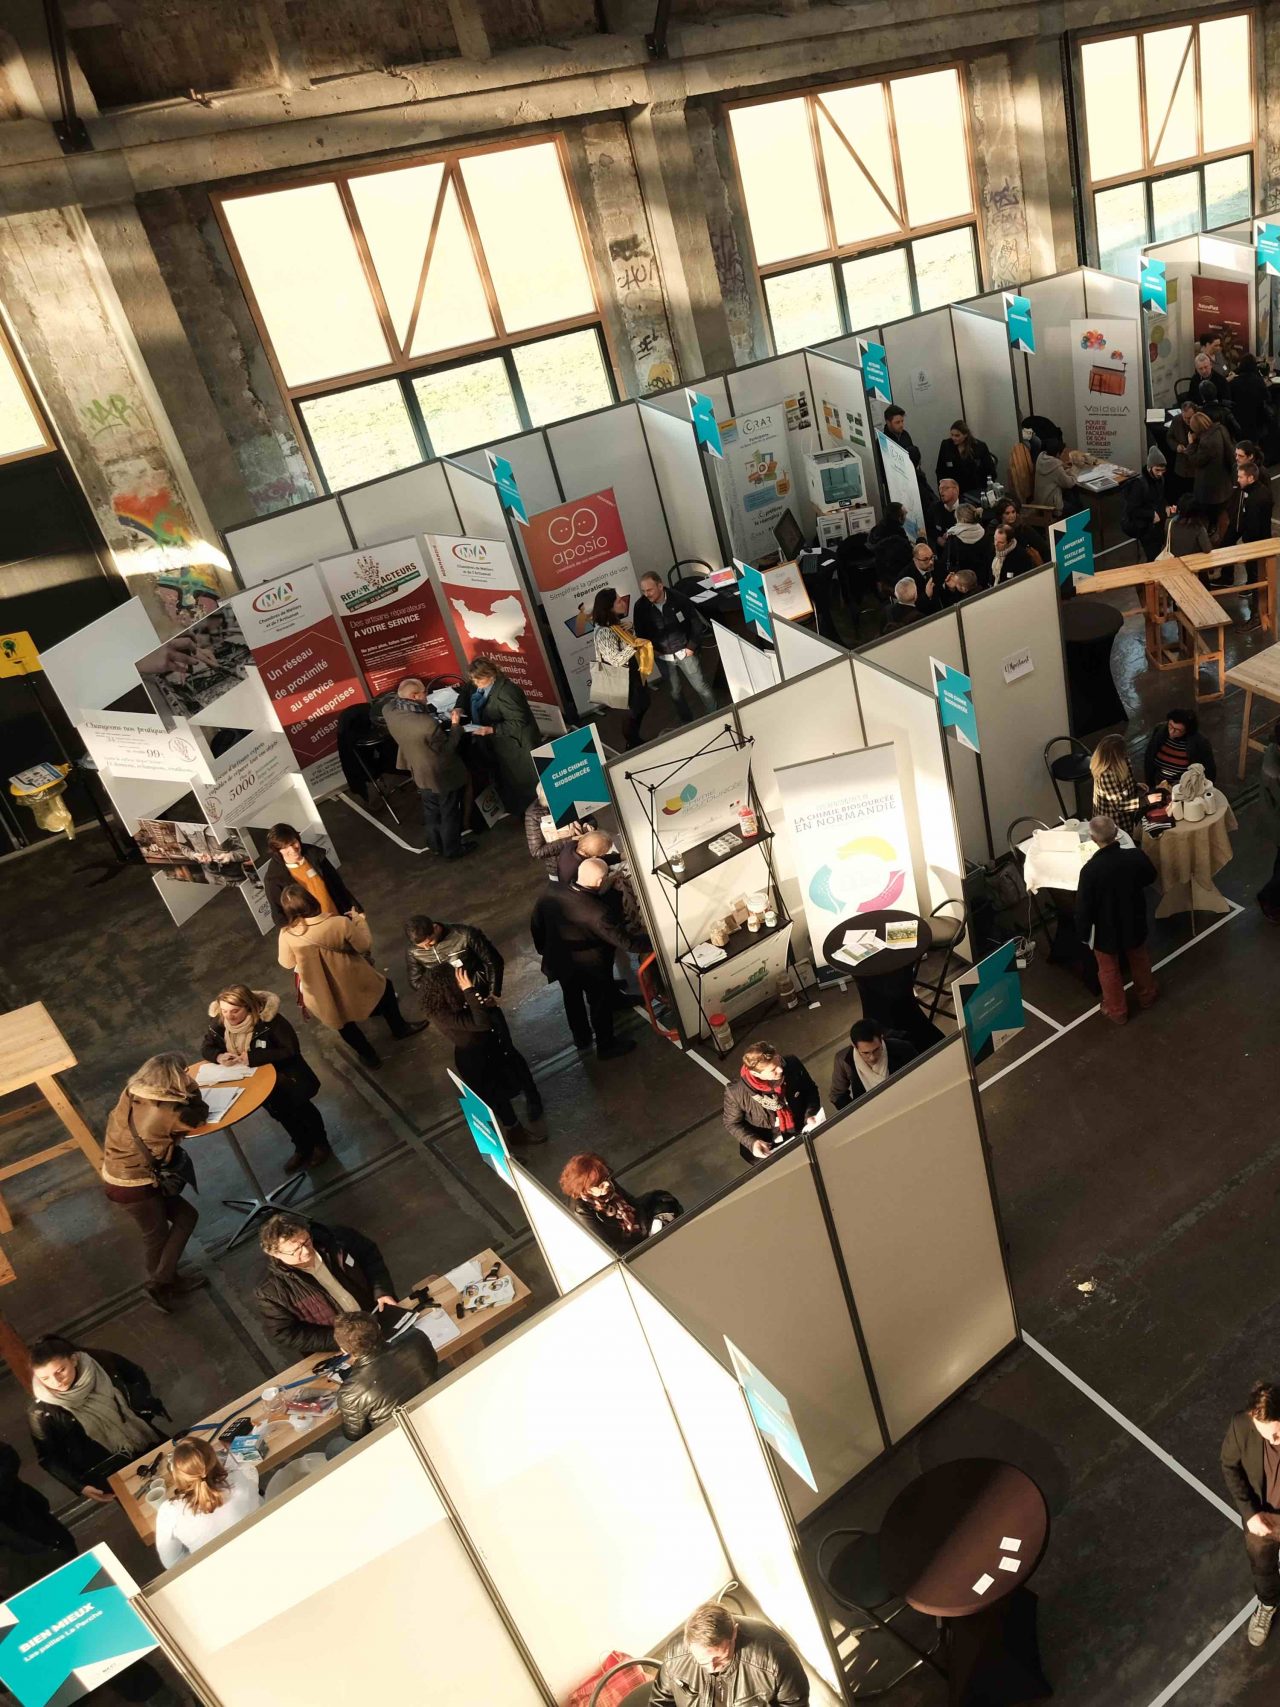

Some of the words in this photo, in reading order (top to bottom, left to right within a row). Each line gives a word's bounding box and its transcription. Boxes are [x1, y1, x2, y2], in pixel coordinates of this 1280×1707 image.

[552, 536, 608, 566] aposio
[380, 562, 417, 584] ACTEURS
[573, 580, 610, 600] réparations
[361, 623, 388, 636] VOTRE
[388, 613, 421, 629] SERVICE
[266, 668, 282, 681] Un
[282, 647, 314, 672] réseau
[274, 688, 287, 700] de
[287, 658, 328, 694] proximité
[290, 702, 303, 712] au
[302, 678, 335, 704] service
[290, 720, 308, 735] des
[308, 686, 356, 722] entreprises
[86, 722, 122, 732] Changeons
[552, 768, 568, 780] CLUB
[568, 758, 588, 772] CHIMIE
[554, 766, 590, 788] BIOSOURCÉE
[228, 774, 256, 801] 5000
[795, 822, 812, 834] EN
[816, 801, 896, 828] NORMANDIE
[806, 808, 840, 822] CHIMIE
[842, 794, 895, 814] BIOSOURCÉE
[18, 1628, 52, 1654] BIEN
[50, 1602, 95, 1633] MIEUX
